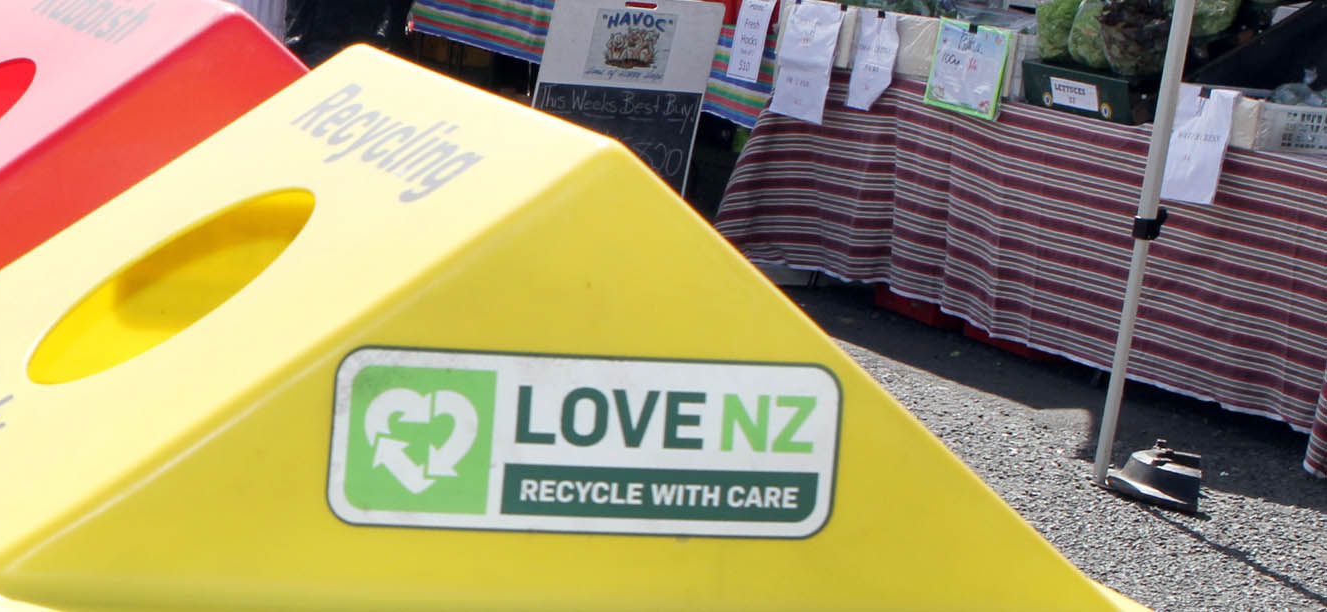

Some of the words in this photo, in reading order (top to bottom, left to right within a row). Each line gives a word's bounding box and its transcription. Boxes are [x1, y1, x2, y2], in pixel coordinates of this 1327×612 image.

[572, 88, 618, 113] Weeks
[620, 90, 659, 114] Best
[290, 83, 484, 203] Recycling
[514, 385, 707, 450] LOVE
[720, 393, 818, 454] NZ
[519, 478, 643, 506] RECYCLE
[650, 483, 724, 507] WITH
[727, 486, 800, 509] CARE
